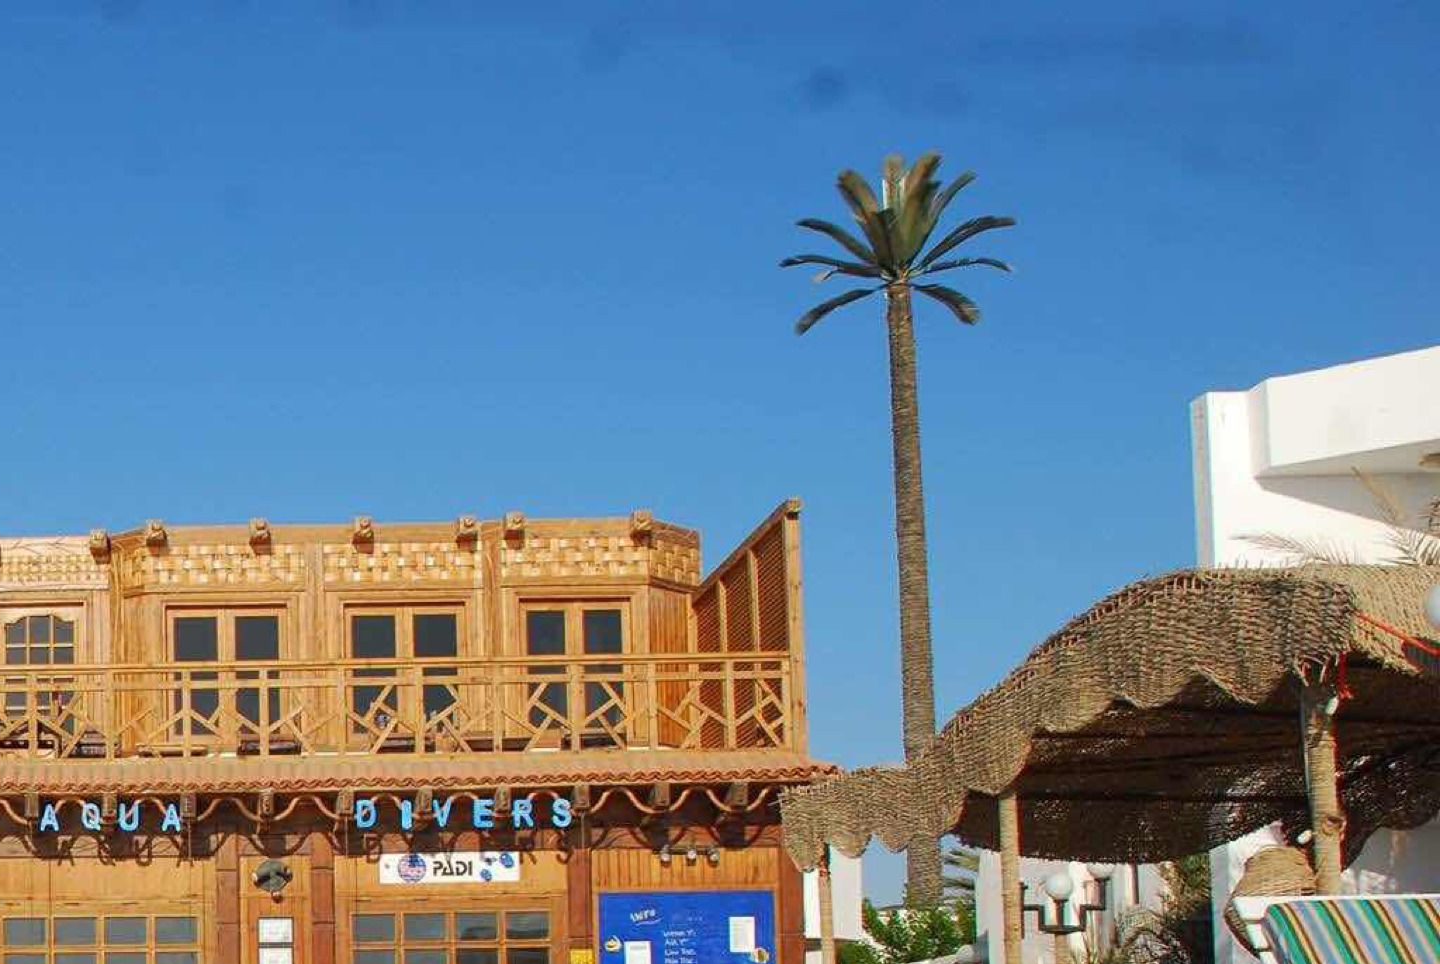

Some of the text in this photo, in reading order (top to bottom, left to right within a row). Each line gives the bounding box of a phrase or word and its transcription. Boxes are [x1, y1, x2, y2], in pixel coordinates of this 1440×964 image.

[40, 798, 573, 832] AQUA DIVERS
[432, 860, 474, 877] PADI
